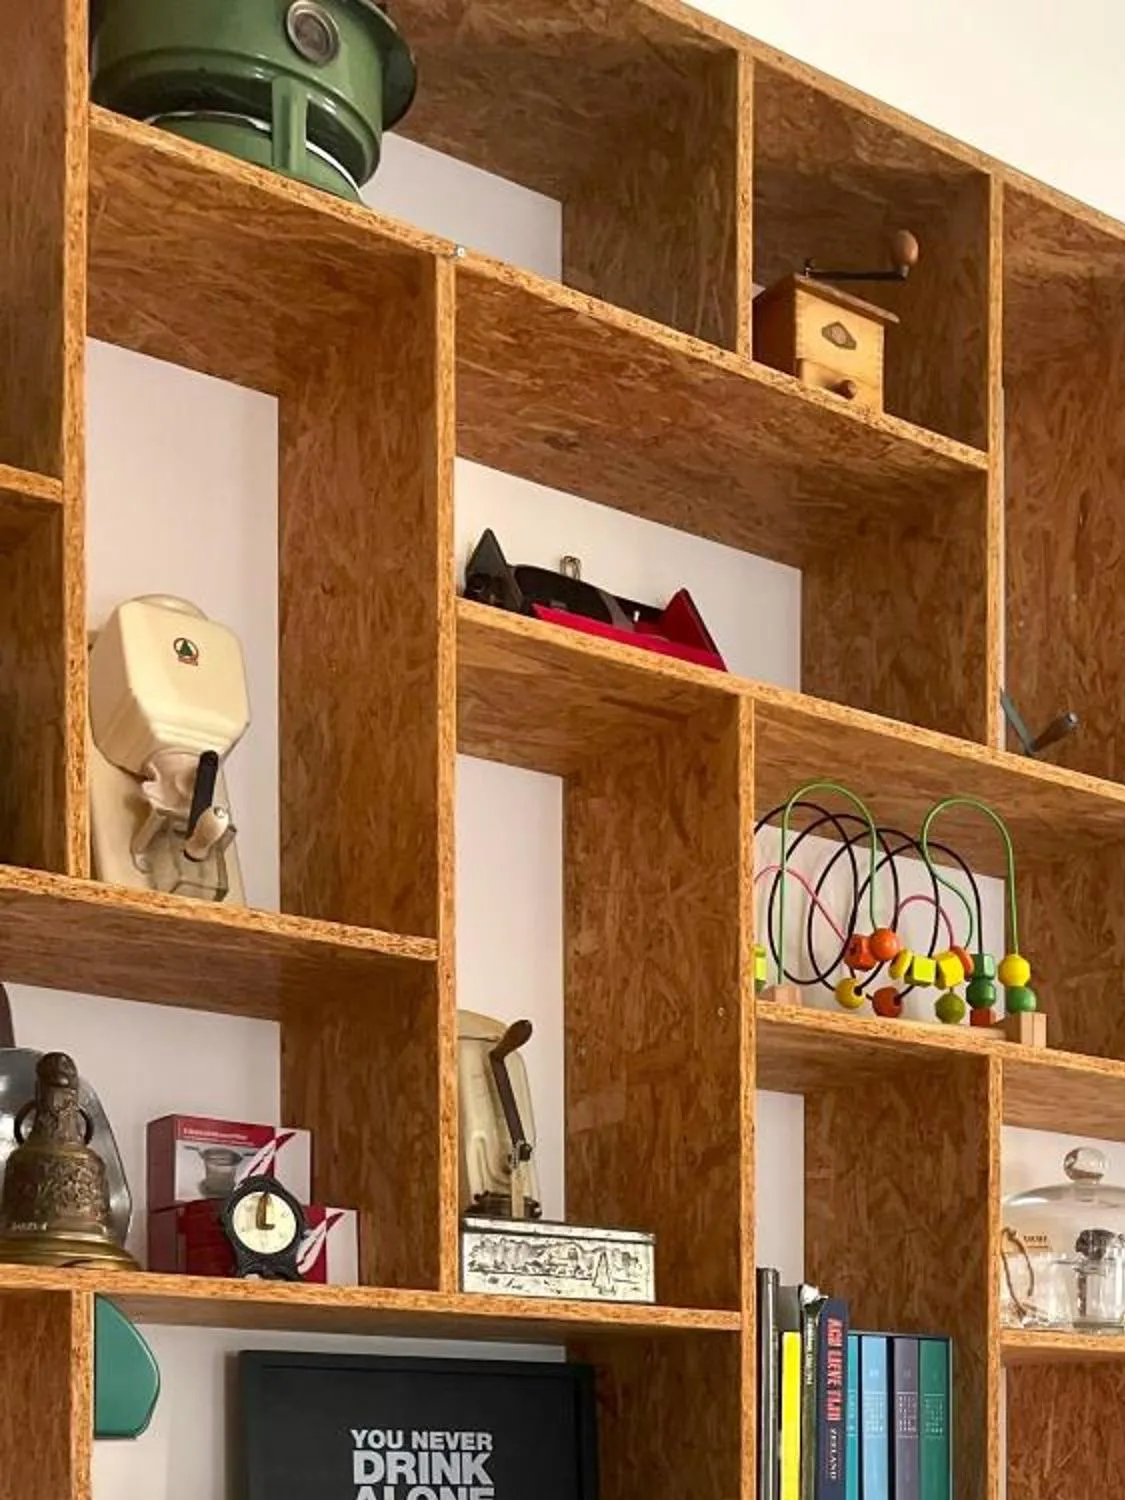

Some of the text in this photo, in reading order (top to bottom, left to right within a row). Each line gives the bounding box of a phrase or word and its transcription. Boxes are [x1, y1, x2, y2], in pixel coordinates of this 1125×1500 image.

[350, 1428, 494, 1451] YOU NEVER
[353, 1450, 494, 1485] DRINK
